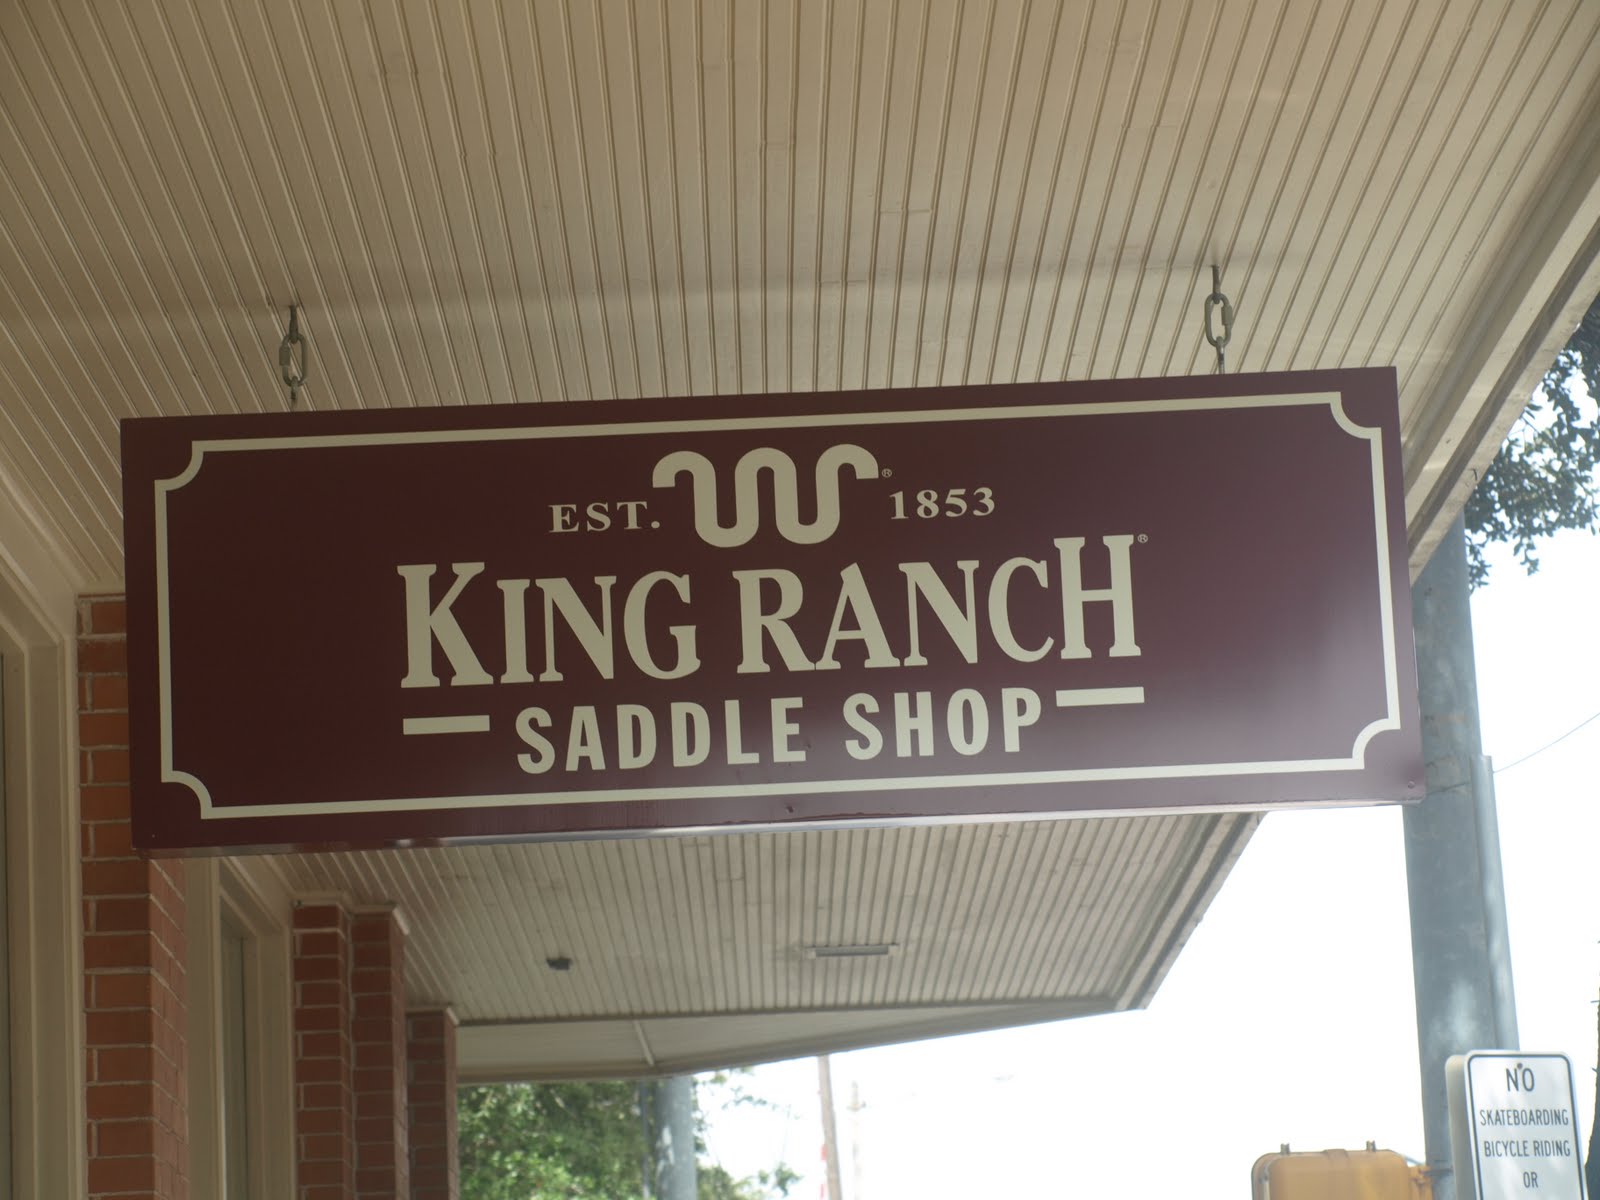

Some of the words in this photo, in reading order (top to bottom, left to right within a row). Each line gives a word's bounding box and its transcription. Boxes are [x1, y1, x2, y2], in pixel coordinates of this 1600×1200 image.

[549, 501, 661, 534] EST.
[889, 486, 996, 521] 1853
[397, 561, 702, 689] KING
[732, 533, 1142, 674] RANCH
[515, 696, 807, 775] SADDLE
[844, 686, 1042, 760] SHOP
[1505, 1067, 1535, 1092] NO
[1479, 1109, 1569, 1126] SKATEBOARDING
[1483, 1140, 1530, 1157] BICYCLE
[1533, 1140, 1571, 1157] RIDING
[1522, 1171, 1539, 1189] OR
